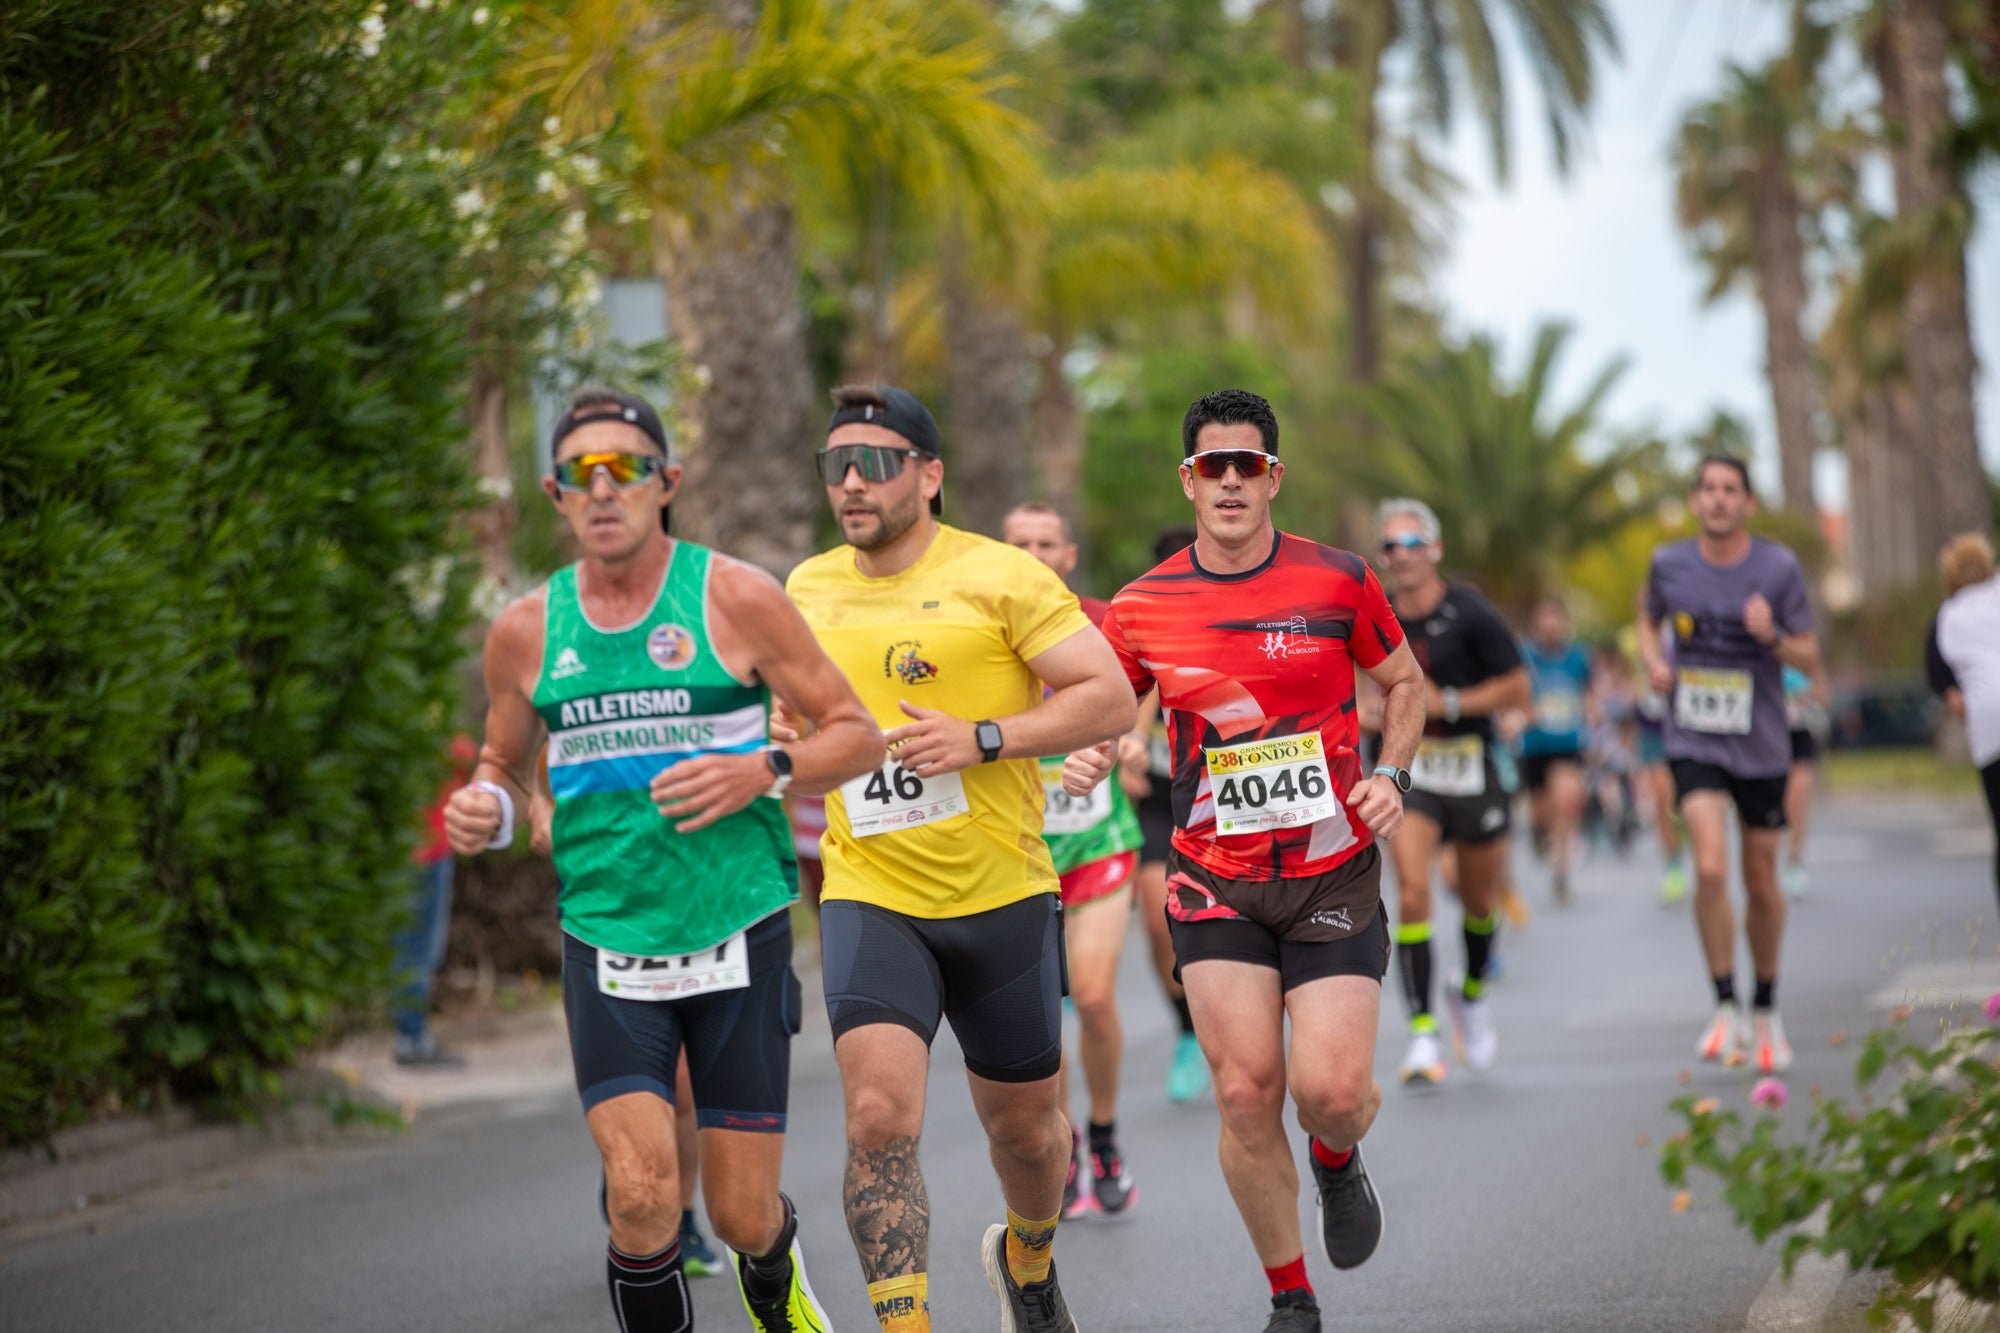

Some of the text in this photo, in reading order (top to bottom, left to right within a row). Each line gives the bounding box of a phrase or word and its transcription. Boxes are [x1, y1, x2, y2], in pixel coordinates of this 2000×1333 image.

[1256, 621, 1291, 629] ATLETISMO
[1287, 647, 1320, 655] ALBOLOTE
[560, 689, 692, 728] ATLETISMO
[1219, 745, 1299, 768] 38 FONDO
[1240, 746, 1262, 755] GRAN
[1263, 740, 1292, 751] PREMIO
[864, 765, 924, 806] 46
[1217, 765, 1326, 811] 4046
[1317, 915, 1351, 932] ALBOLOTE
